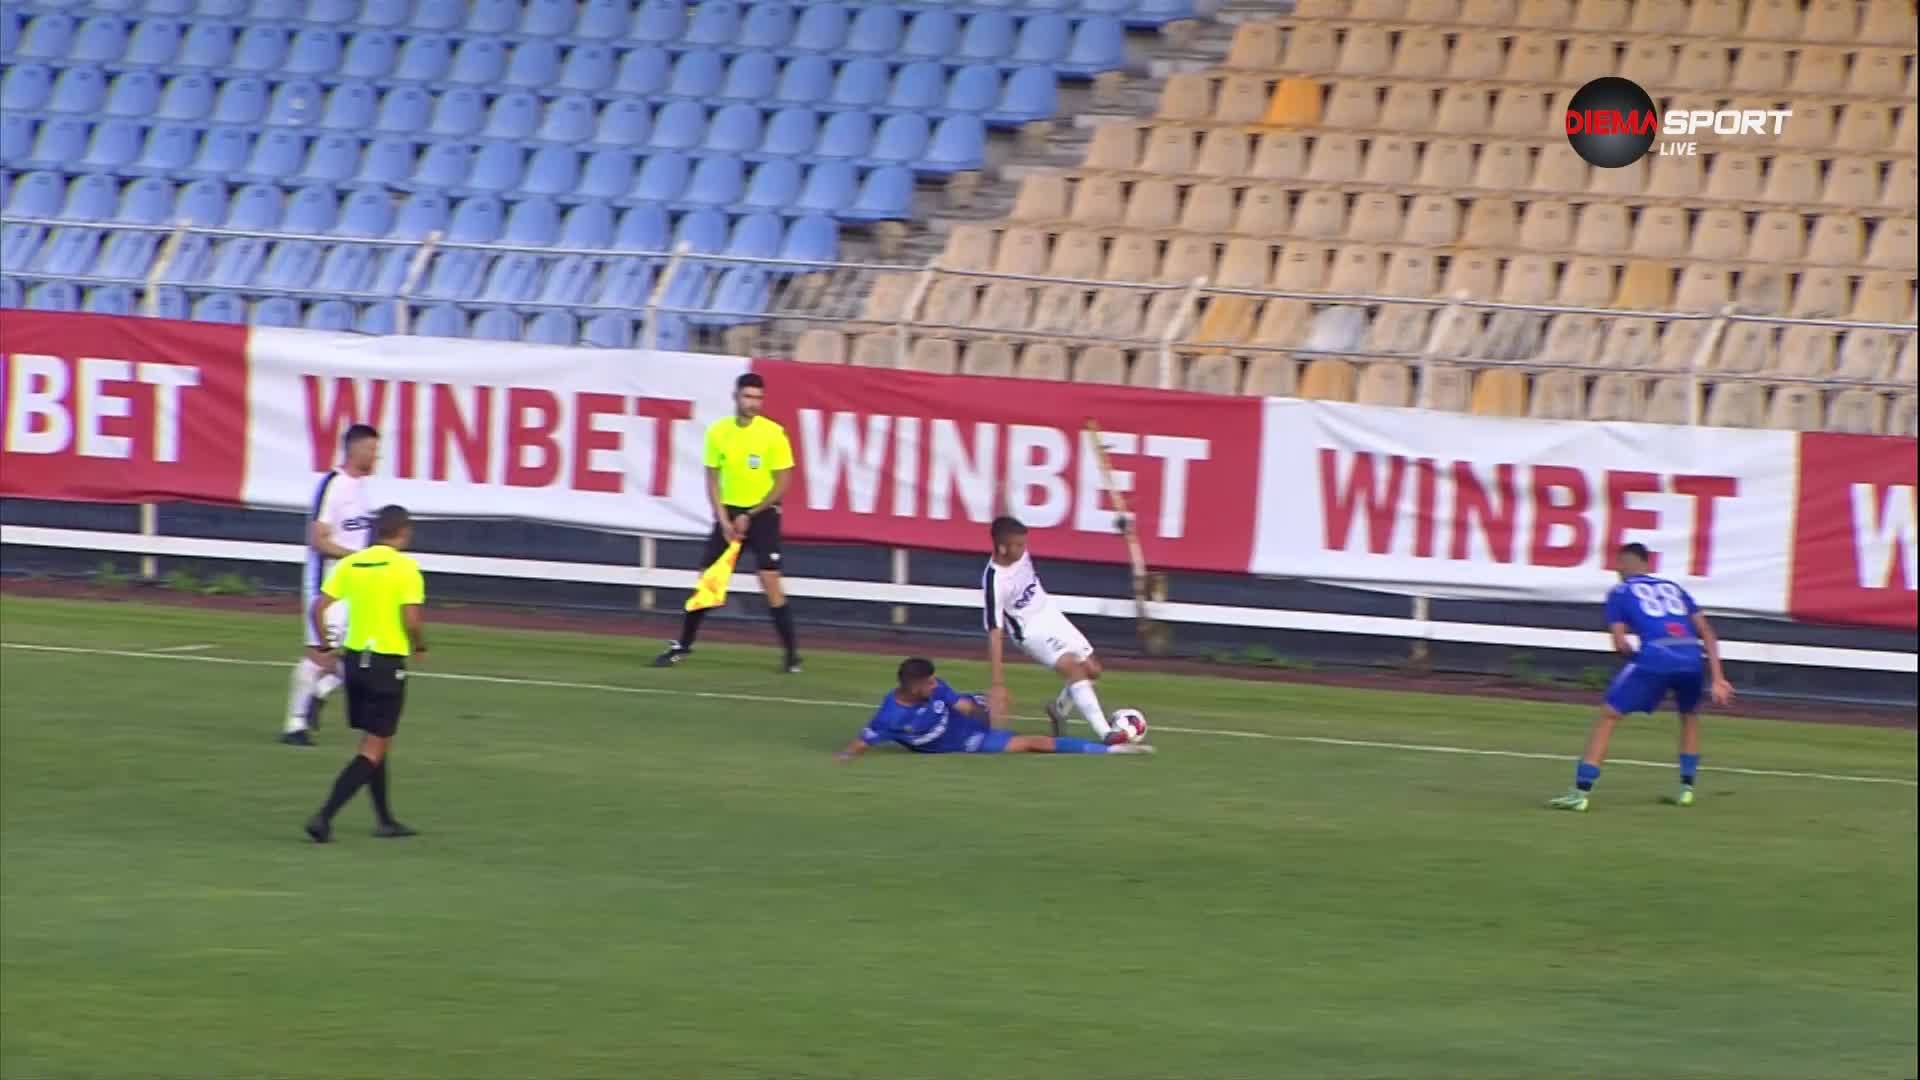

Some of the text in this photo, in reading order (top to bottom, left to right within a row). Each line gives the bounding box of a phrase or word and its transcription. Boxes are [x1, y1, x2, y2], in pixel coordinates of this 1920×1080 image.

[304, 374, 693, 497] WINBET
[799, 409, 1210, 538] WINBET
[1319, 448, 1737, 577] WINBET
[1632, 583, 1688, 617] 88
